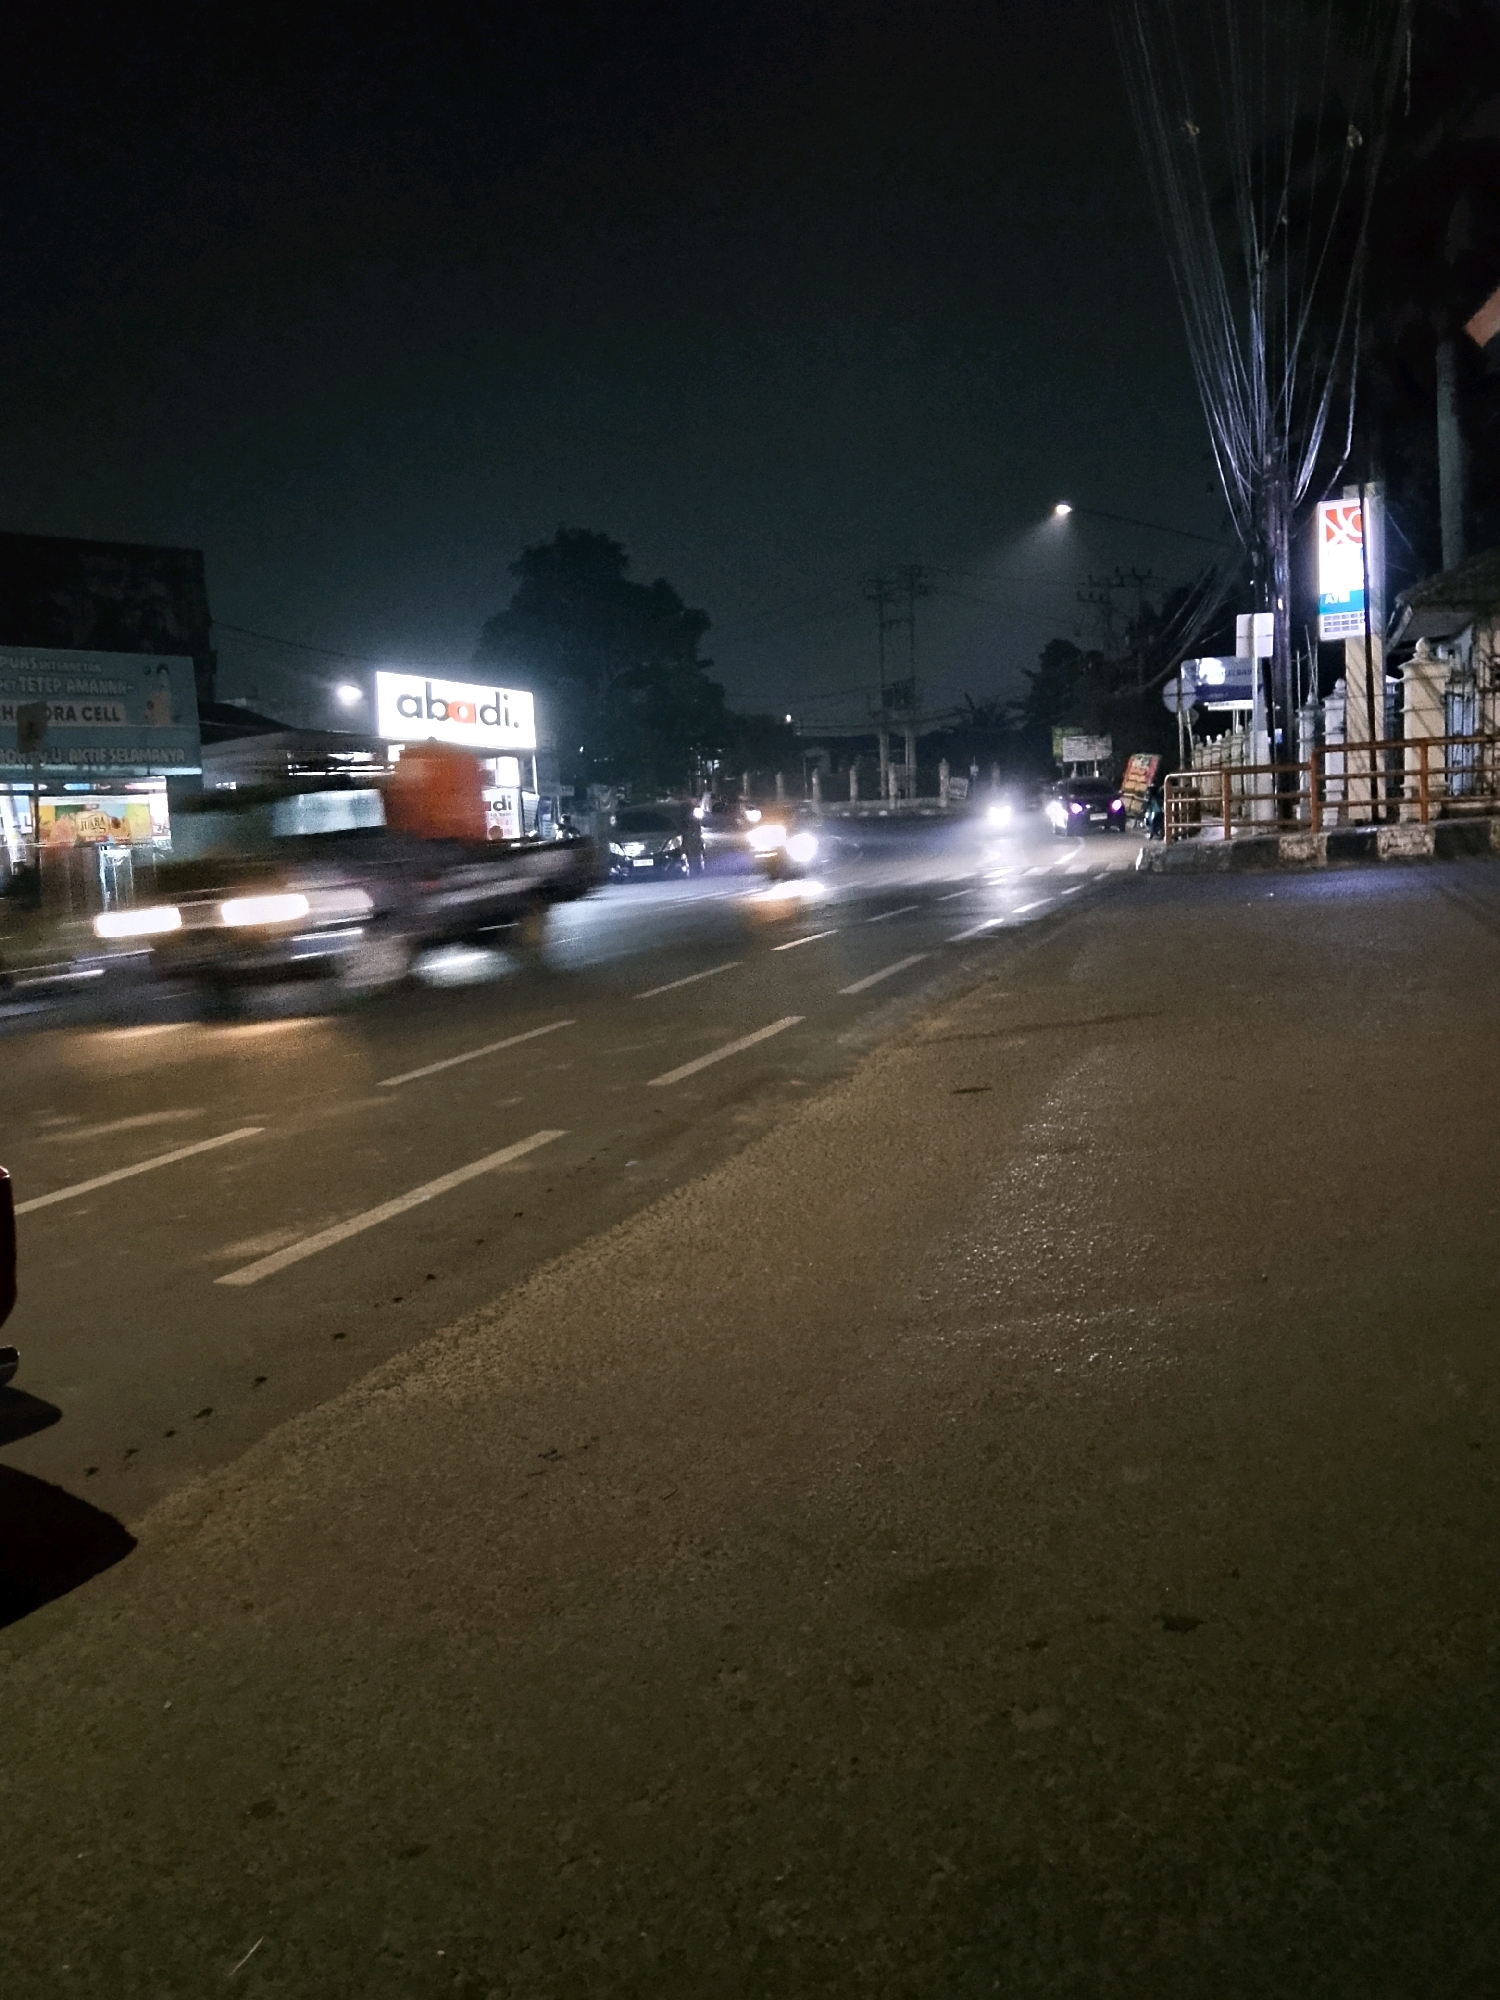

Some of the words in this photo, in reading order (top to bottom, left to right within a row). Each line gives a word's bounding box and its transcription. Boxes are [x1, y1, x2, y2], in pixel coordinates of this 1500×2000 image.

[18, 675, 62, 694] TETEP
[396, 681, 520, 728] abadi.
[81, 706, 121, 722] CELL
[68, 747, 106, 764] AKTIF
[109, 746, 186, 763] SELAMANYA
